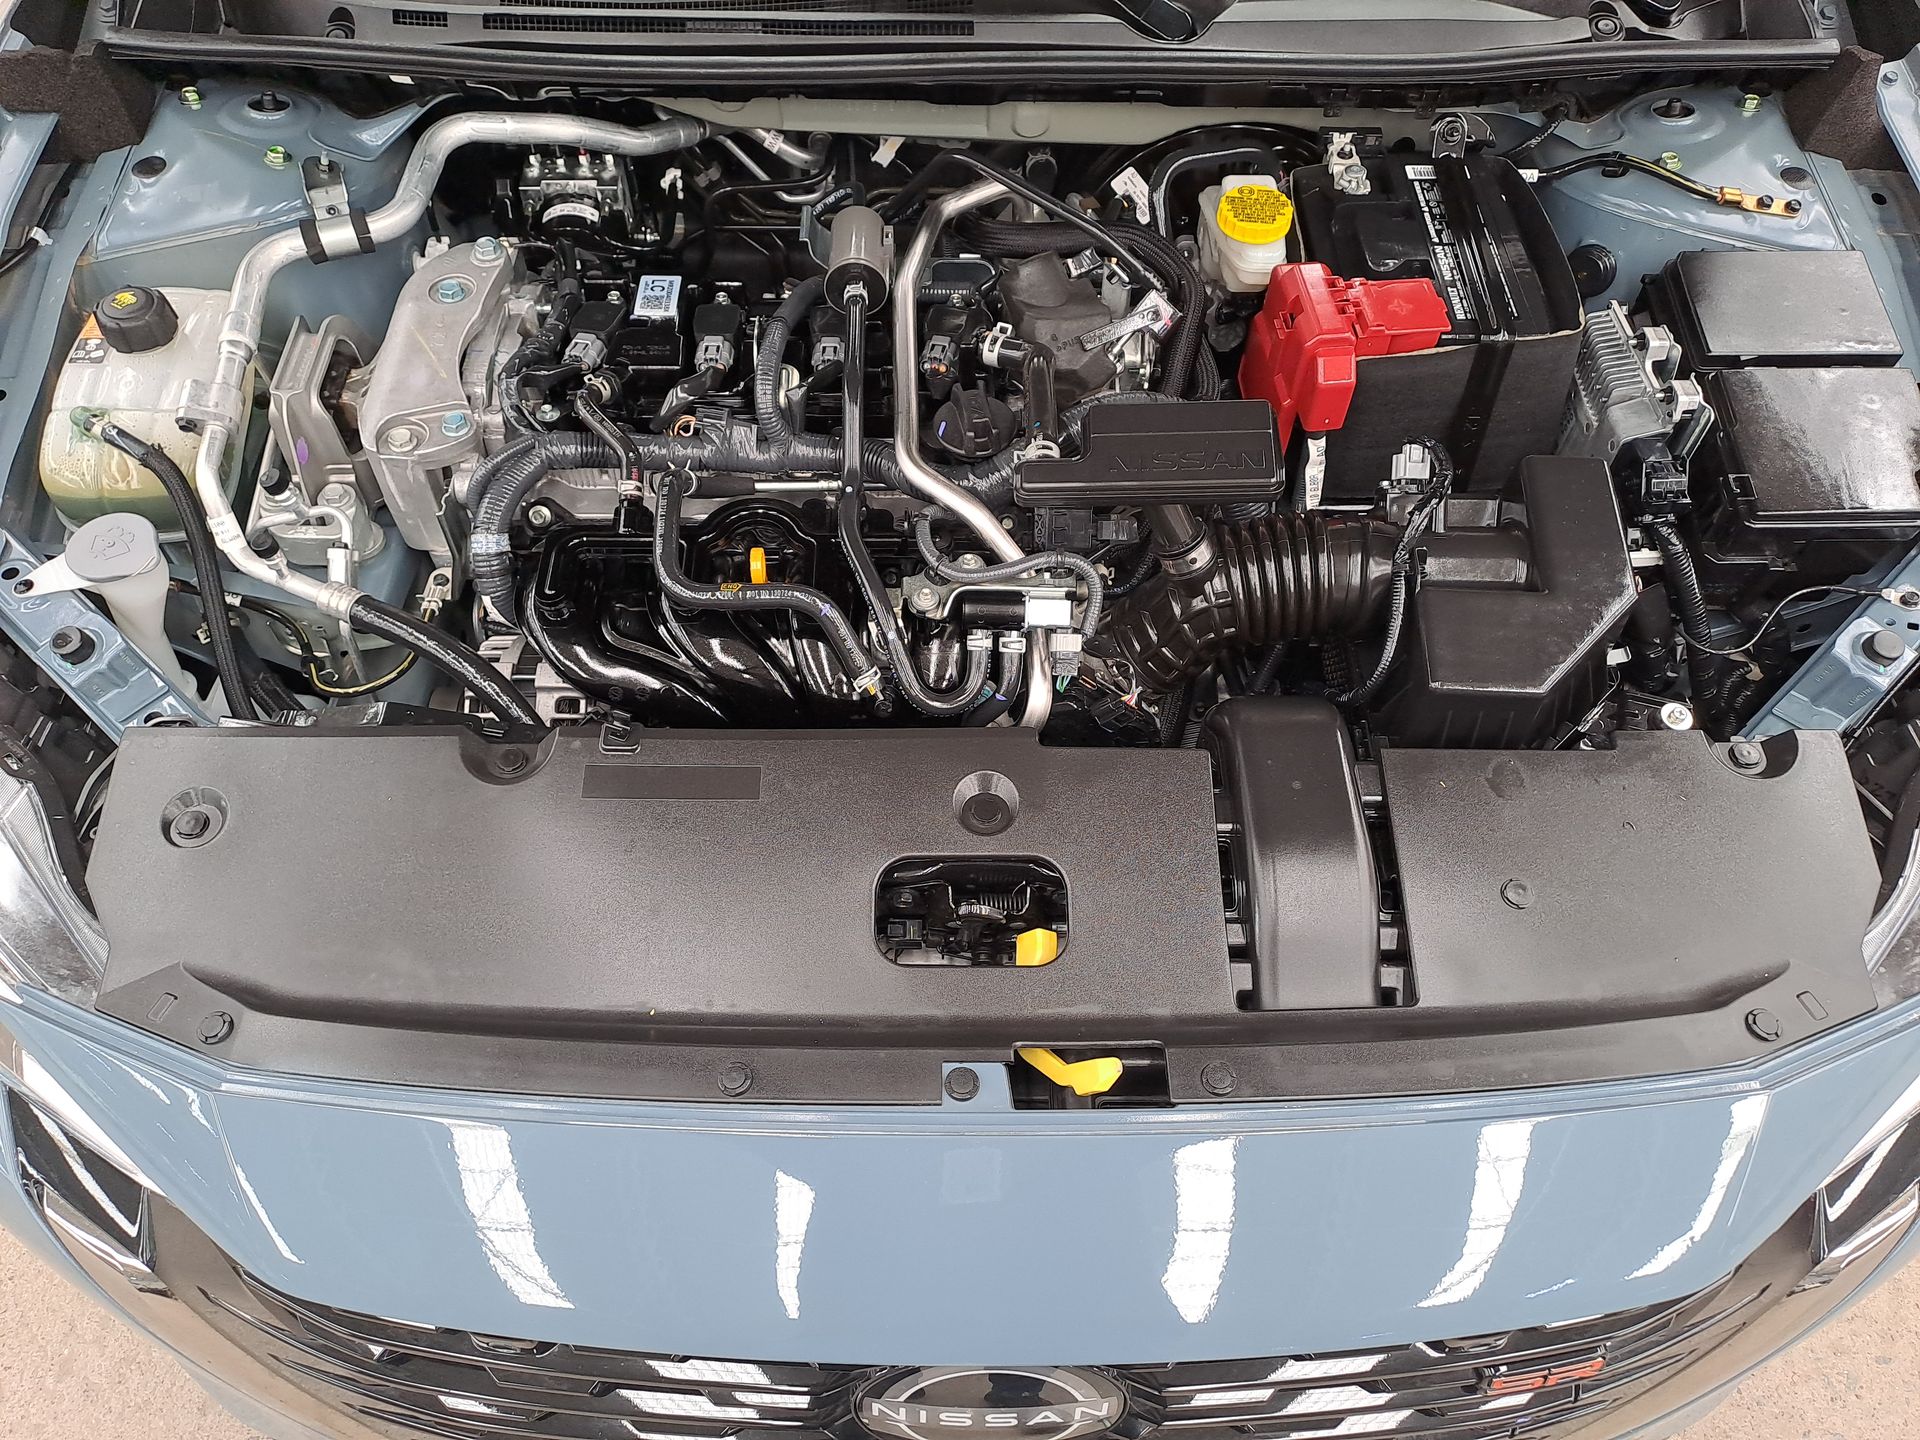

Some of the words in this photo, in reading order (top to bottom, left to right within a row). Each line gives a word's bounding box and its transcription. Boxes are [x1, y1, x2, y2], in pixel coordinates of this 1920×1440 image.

[1434, 246, 1454, 281] NISSAN
[650, 279, 666, 293] LC
[1447, 286, 1467, 321] RENAULT
[1110, 449, 1266, 472] NISSAN
[871, 1401, 1110, 1427] NISSAN
